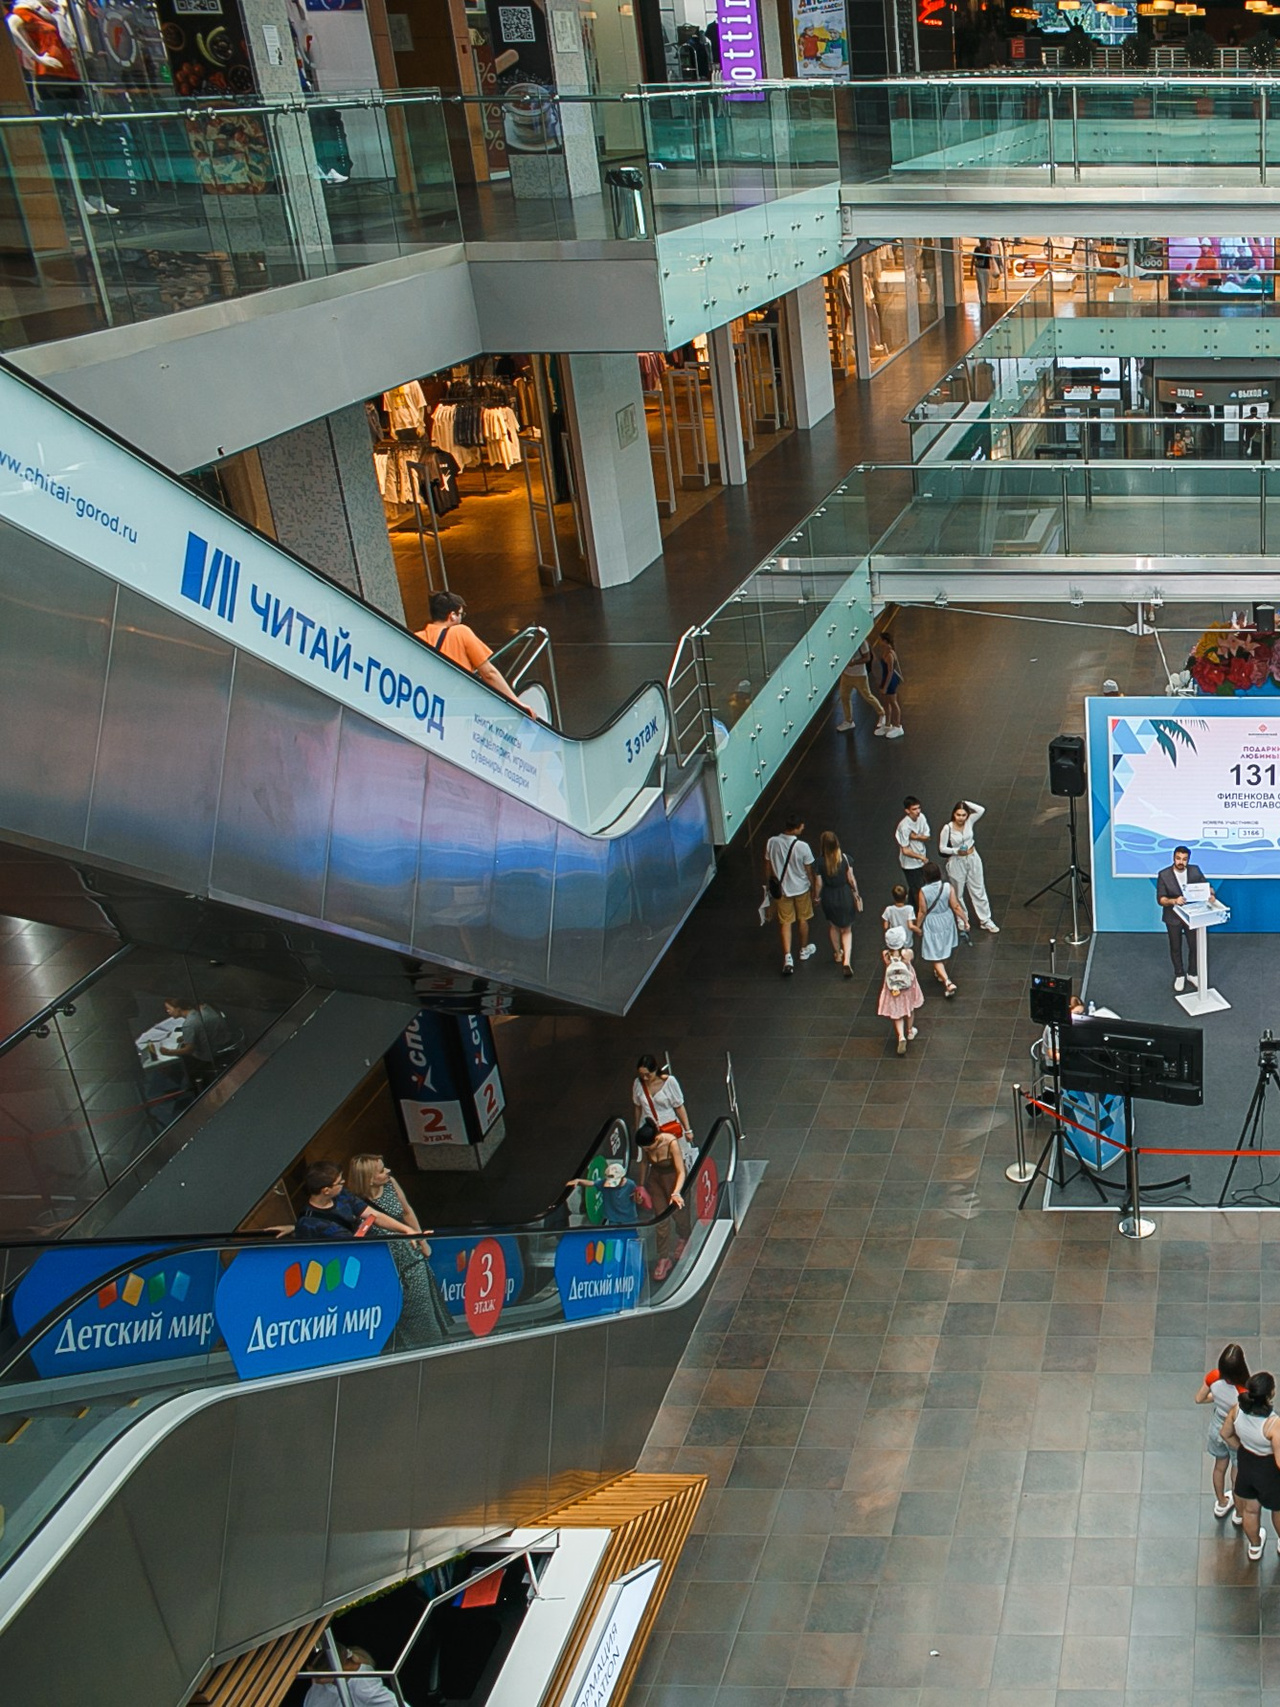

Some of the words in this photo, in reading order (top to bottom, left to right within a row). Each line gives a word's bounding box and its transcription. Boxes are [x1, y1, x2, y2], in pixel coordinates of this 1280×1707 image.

[1177, 388, 1195, 398] ВХОД
[1238, 389, 1262, 398] ВЫХОД
[250, 583, 446, 741] ЧИТАЙ-ГОРОД
[625, 738, 634, 764] 3
[634, 715, 660, 755] этаж
[1217, 792, 1275, 801] ФИЛЕНКОВА
[483, 1083, 497, 1115] 2
[420, 1107, 448, 1133] 2
[423, 1133, 453, 1143] этаж
[480, 1252, 493, 1298] 3
[568, 1275, 613, 1301] Детский
[614, 1274, 635, 1300] мир
[473, 1299, 496, 1315] этаж
[55, 1311, 163, 1355] Детский
[167, 1311, 215, 1347] мир
[247, 1305, 339, 1354] Детский
[341, 1304, 383, 1340] мир
